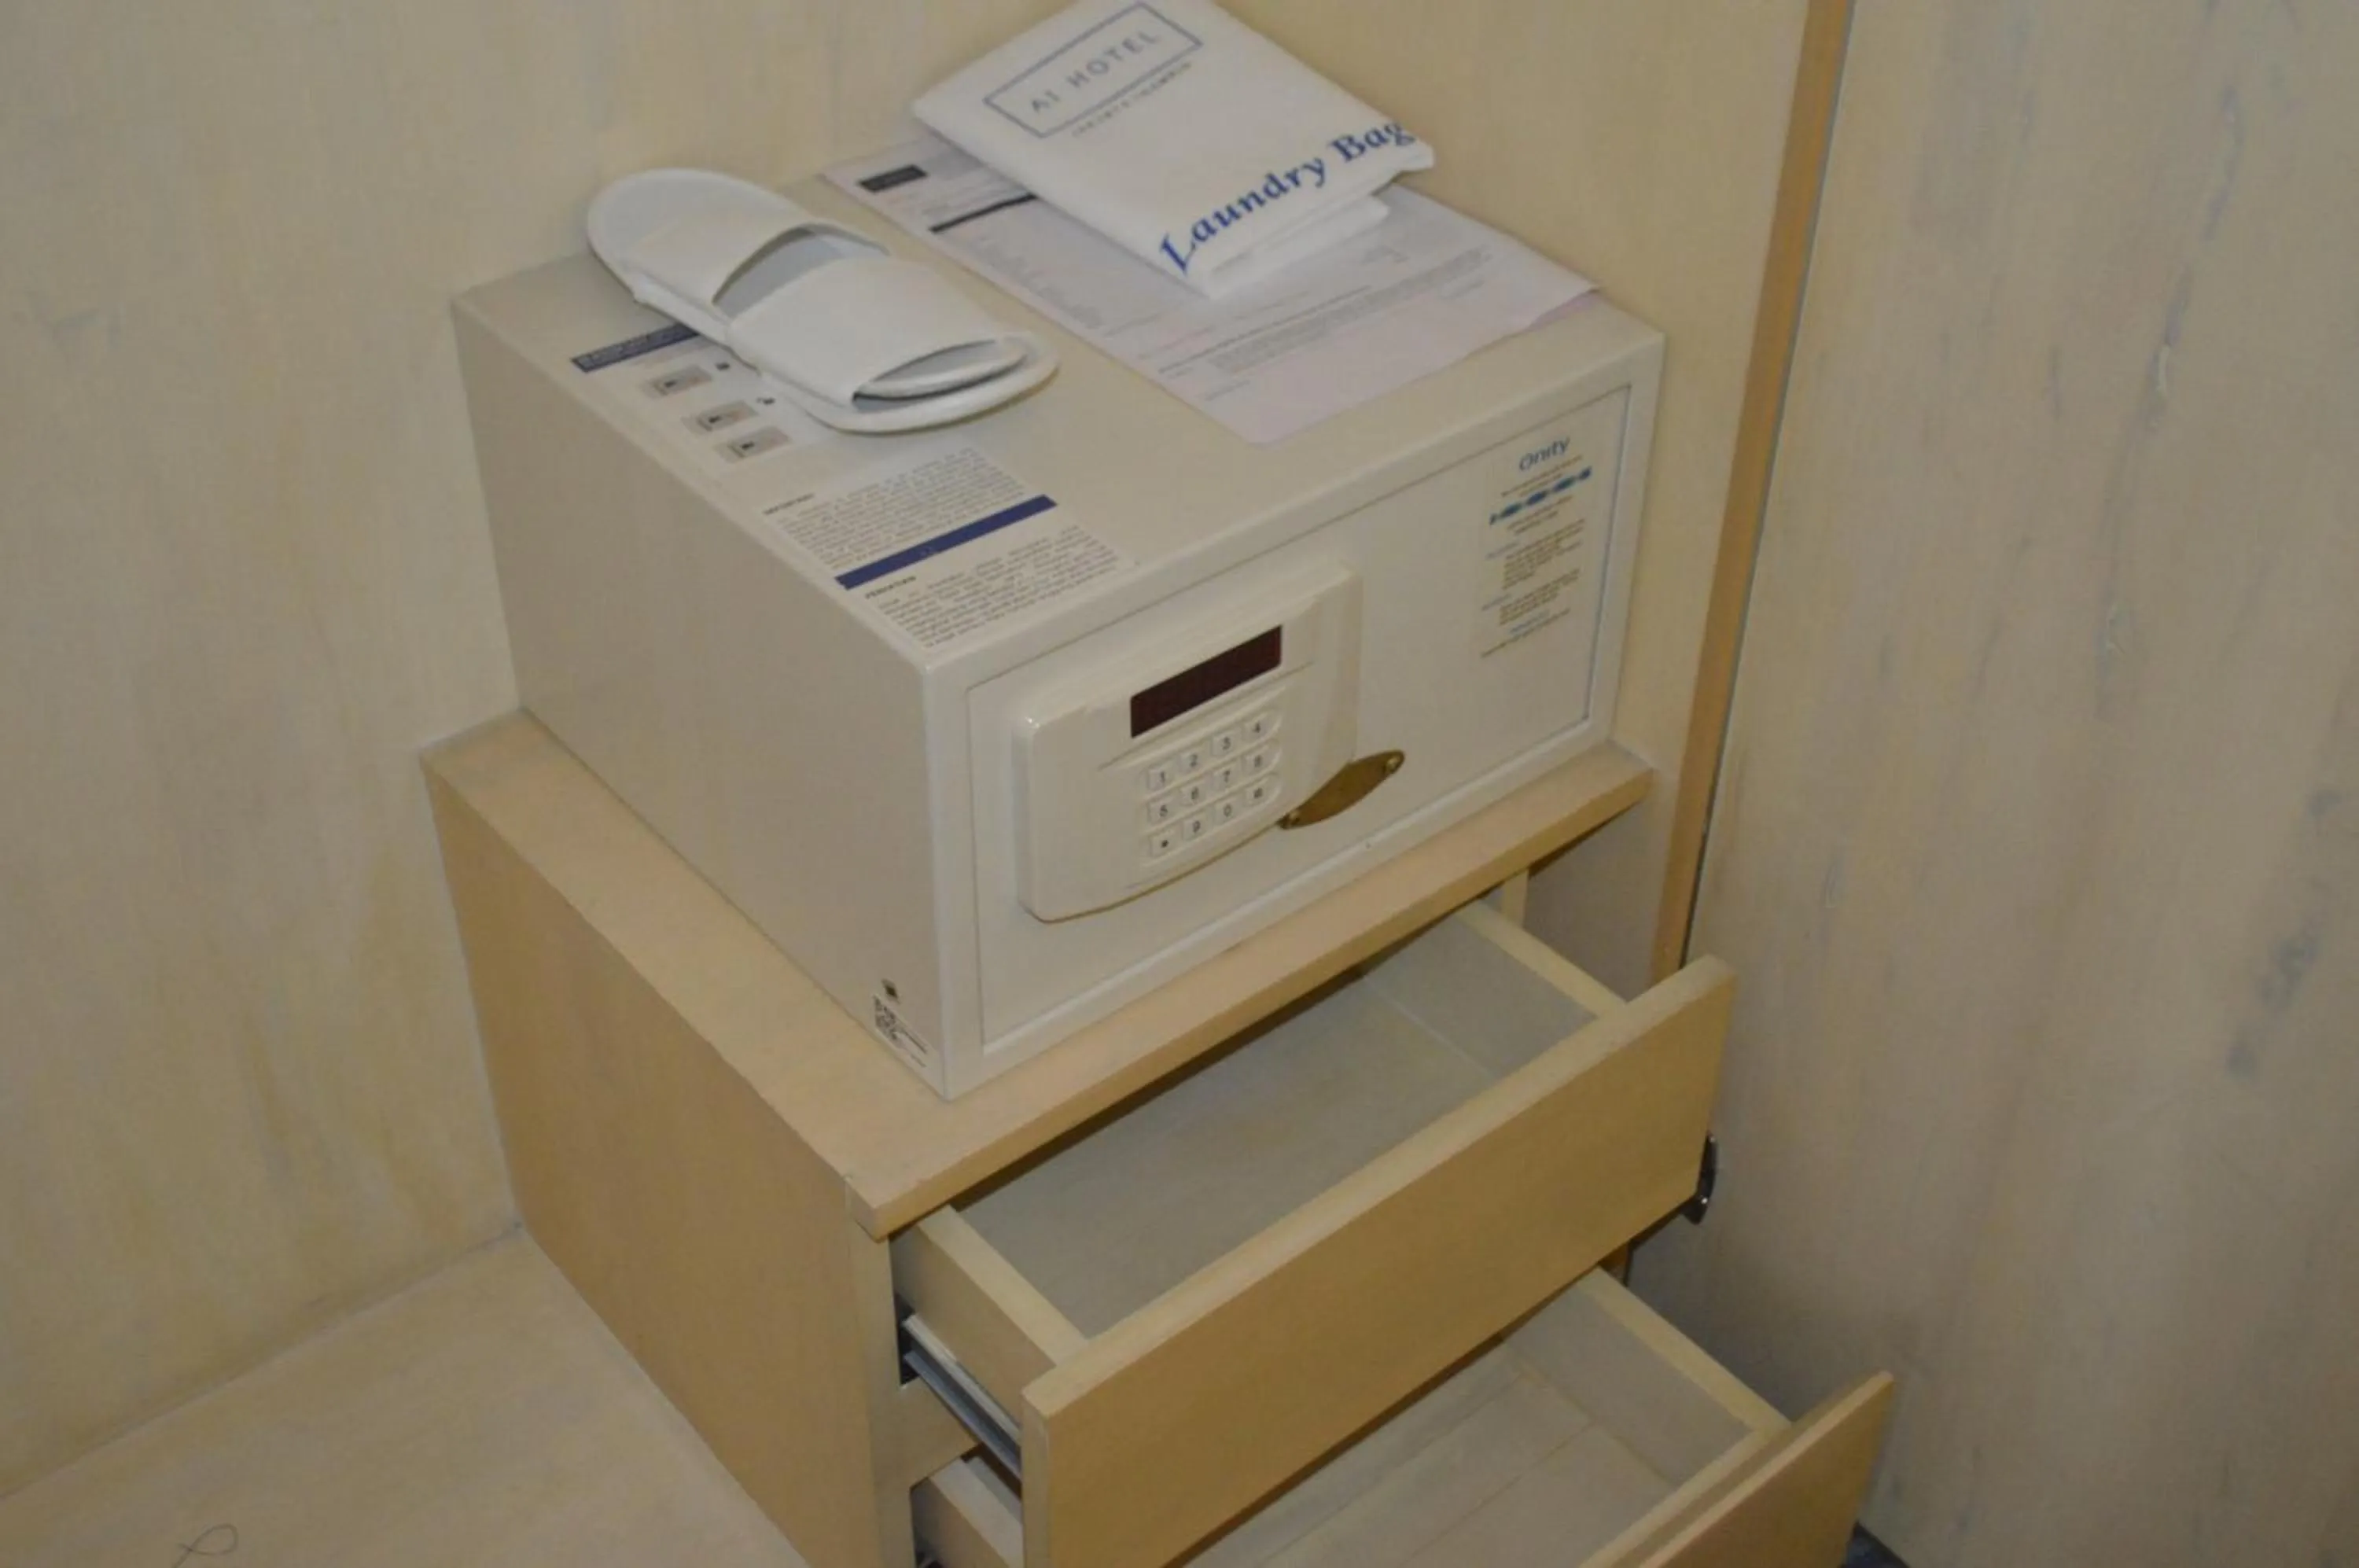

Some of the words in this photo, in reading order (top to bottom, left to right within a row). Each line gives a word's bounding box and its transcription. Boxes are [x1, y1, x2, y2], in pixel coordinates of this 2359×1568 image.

[1065, 31, 1161, 89] HOTEL
[1159, 156, 1327, 275] Laundry
[1327, 122, 1416, 163] Bag
[1518, 436, 1570, 471] Onity
[1189, 753, 1199, 768] 2
[1221, 736, 1232, 751] 3
[1253, 720, 1262, 734] 4
[1159, 804, 1169, 818] 5
[1222, 802, 1234, 818] 0
